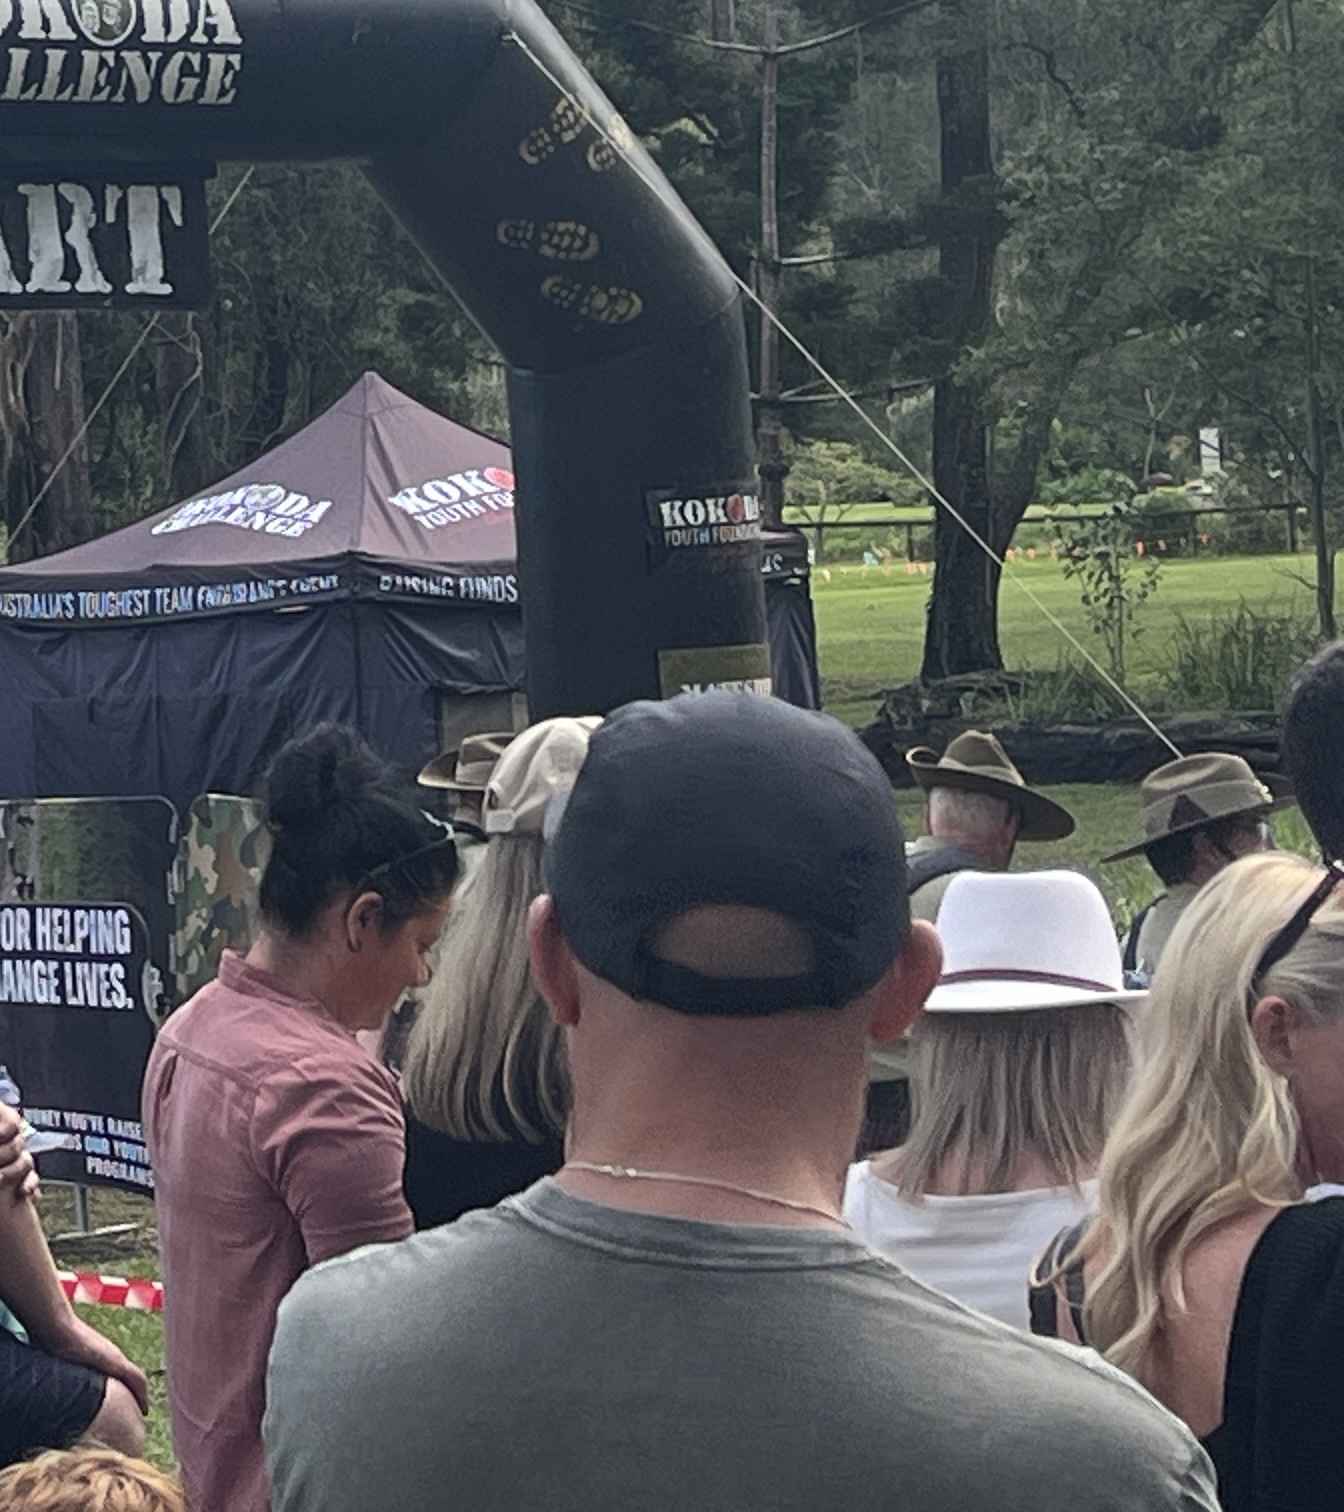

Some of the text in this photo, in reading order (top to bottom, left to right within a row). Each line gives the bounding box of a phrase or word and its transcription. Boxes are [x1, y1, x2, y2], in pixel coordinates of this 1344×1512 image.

[78, 589, 153, 618] TOUGHEST
[154, 584, 194, 615] TEAM
[35, 907, 132, 955] HELPING
[64, 961, 134, 1009] LIVES.
